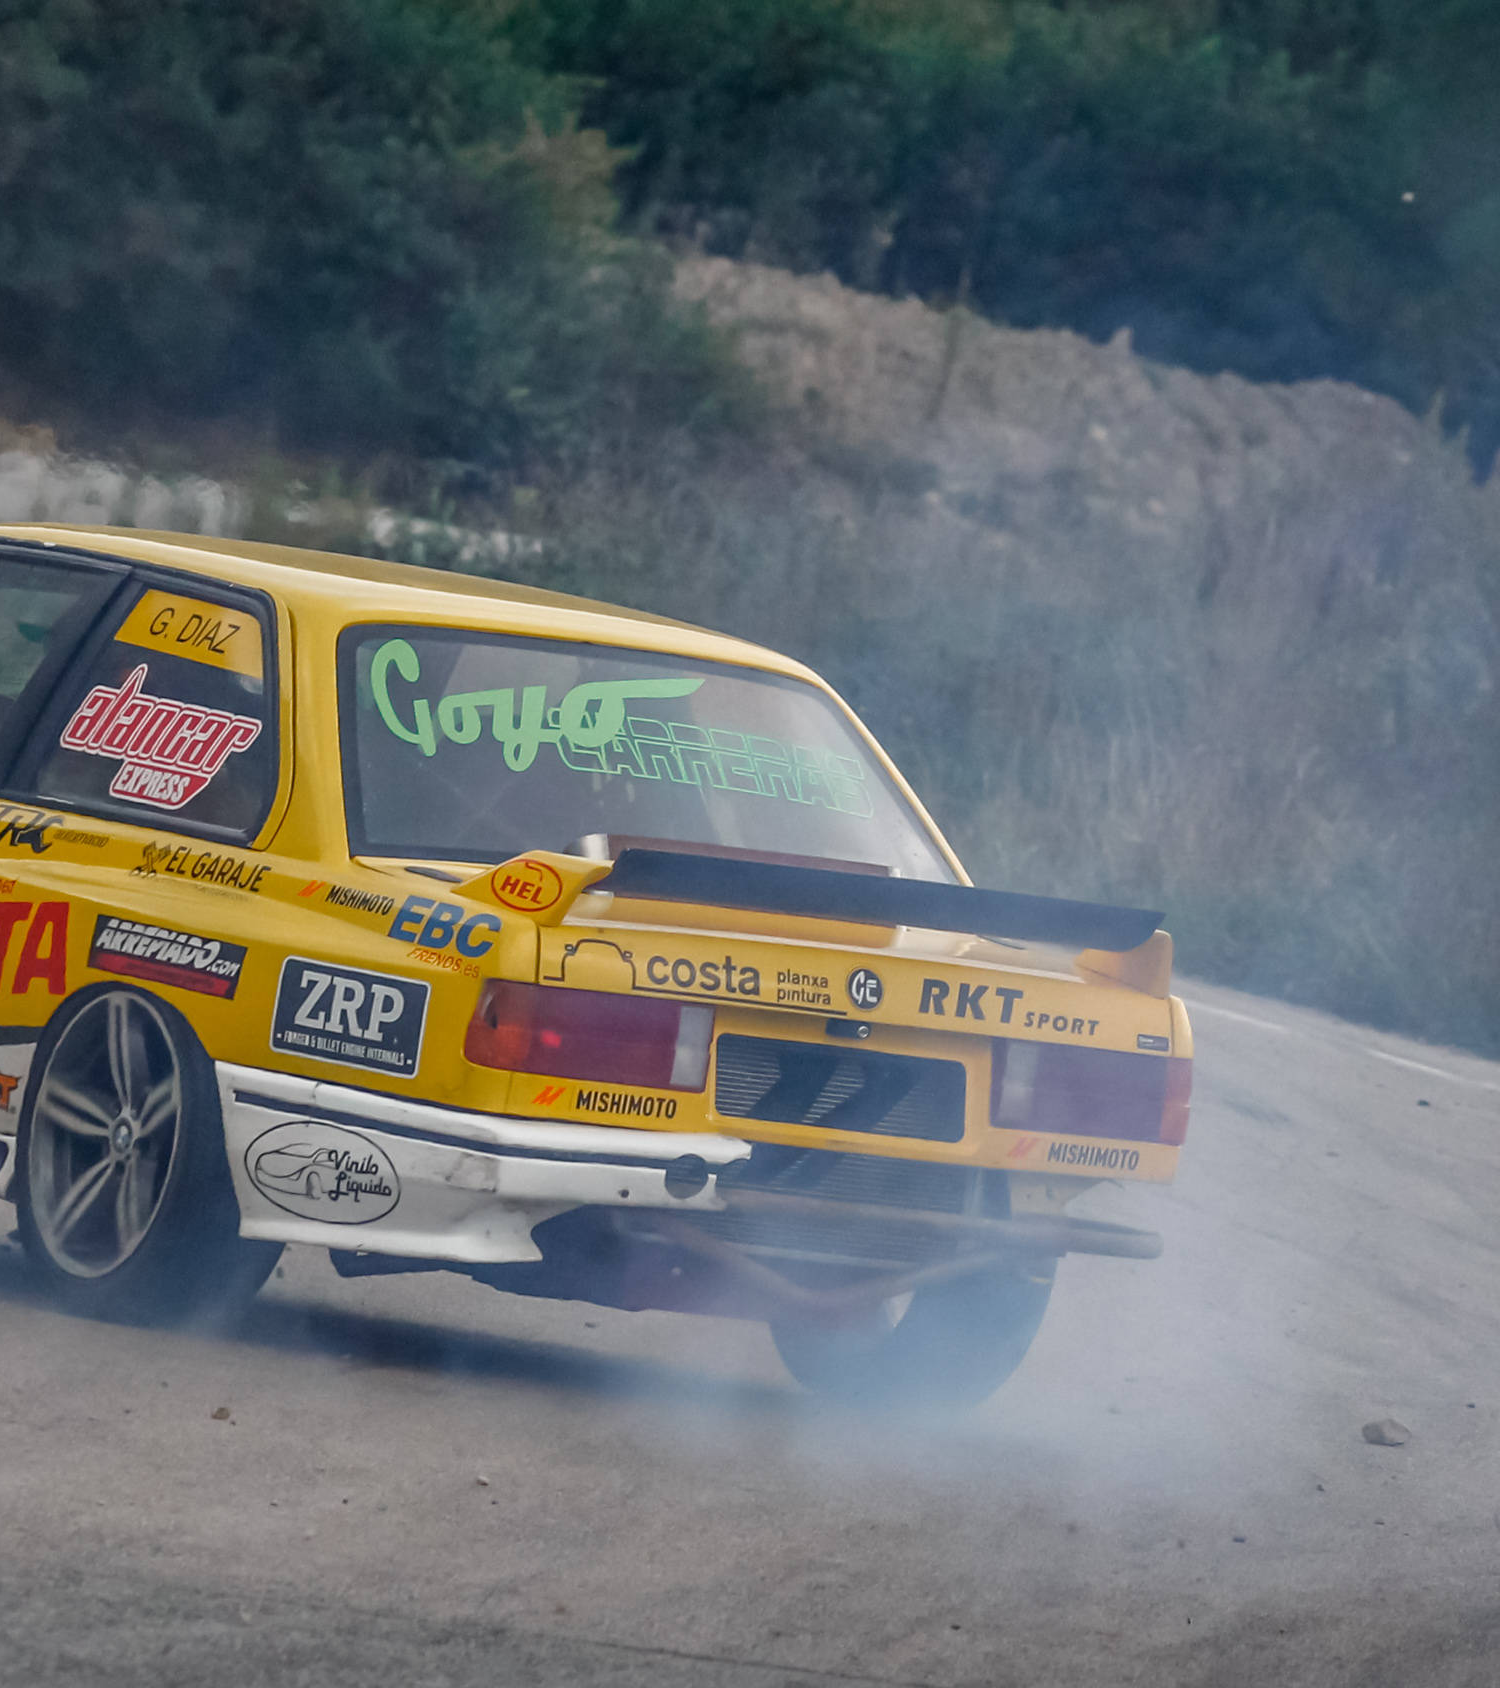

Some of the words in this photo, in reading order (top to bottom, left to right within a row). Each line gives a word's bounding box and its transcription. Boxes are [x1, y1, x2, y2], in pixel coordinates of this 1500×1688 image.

[149, 607, 175, 638] G.
[176, 614, 241, 654] DIAZ
[60, 663, 263, 775] alancar
[370, 638, 706, 773] Goyo
[114, 764, 191, 803] EXPRESS
[165, 846, 192, 875] EL
[191, 852, 272, 892] GARAJE
[325, 885, 395, 916] MISHIMOTO
[500, 874, 546, 905] HEL
[387, 895, 503, 958] EBC
[407, 948, 480, 979] FRENOS.es
[646, 955, 760, 996] costa
[777, 969, 829, 988] planxa
[294, 970, 405, 1042] ZRP
[777, 988, 831, 1006] pintura
[918, 978, 1024, 1024] RKT
[1024, 1011, 1100, 1036] SPORT
[317, 1037, 341, 1053] BILLET
[366, 1047, 405, 1066] INTERNALS
[575, 1089, 677, 1120] MISHIMOTO
[328, 1150, 379, 1176] Vinilo
[1047, 1142, 1140, 1171] MISHIMOTO
